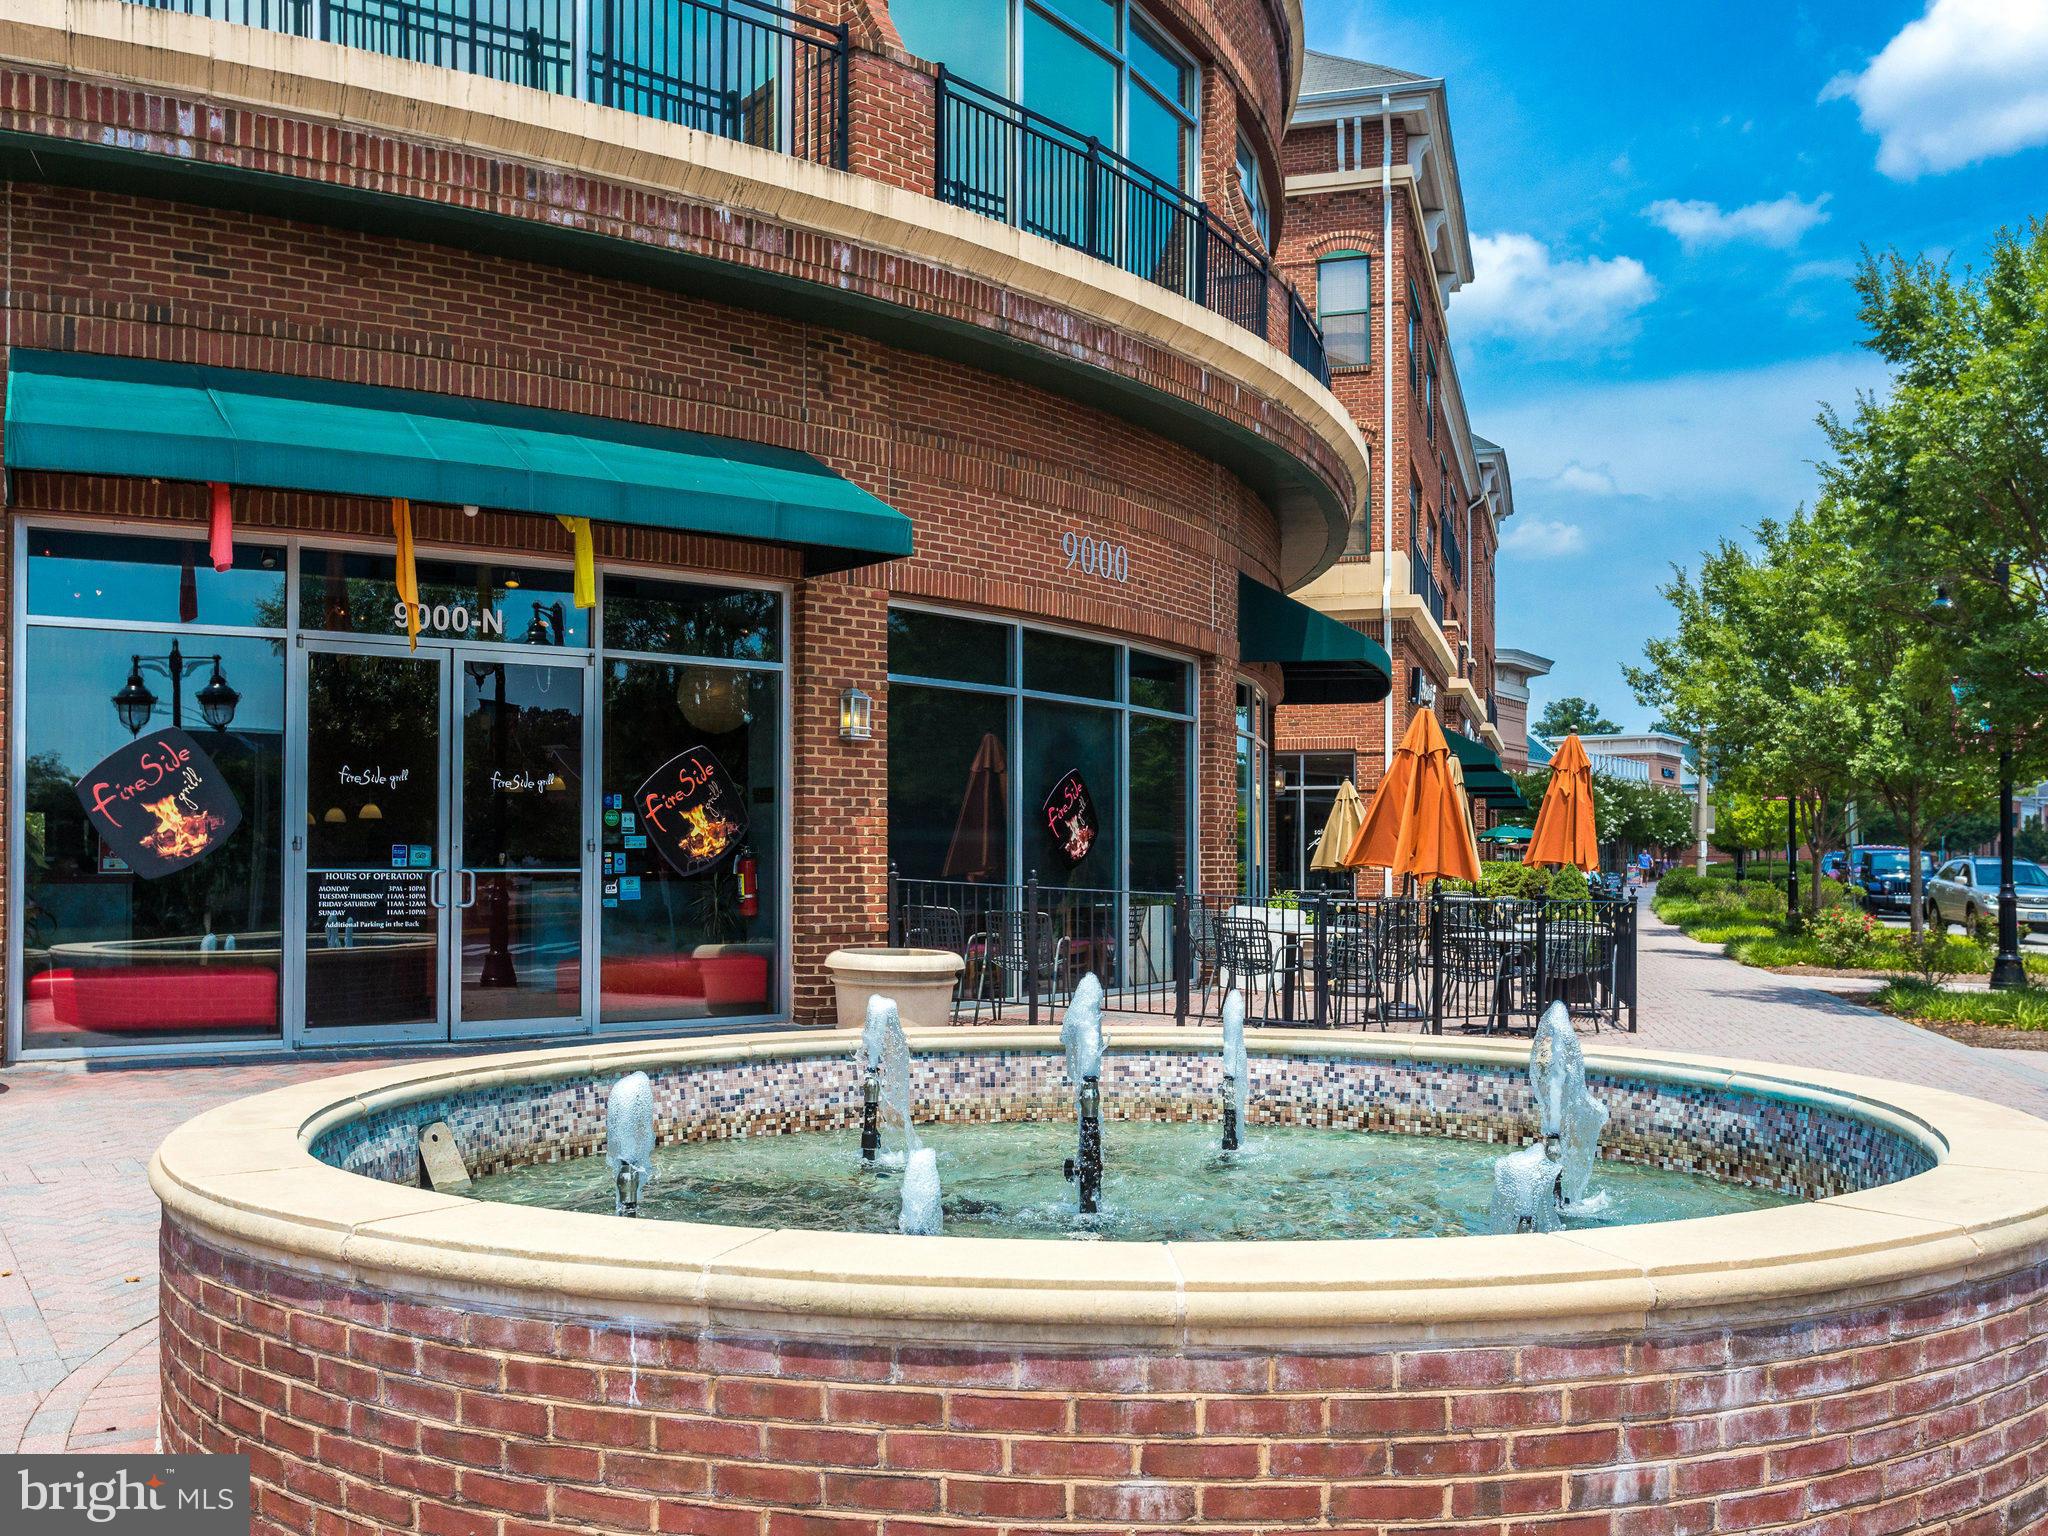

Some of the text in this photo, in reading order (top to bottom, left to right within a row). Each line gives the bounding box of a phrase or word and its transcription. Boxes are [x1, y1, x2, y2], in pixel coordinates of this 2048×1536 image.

[1062, 531, 1128, 583] 9000
[394, 602, 503, 634] 9000-N
[178, 766, 202, 811] grill
[389, 768, 409, 790] grill
[537, 773, 555, 794] grill
[705, 781, 723, 818] grill
[325, 872, 423, 880] HOURS OF OPERATION
[360, 921, 384, 930] Parking
